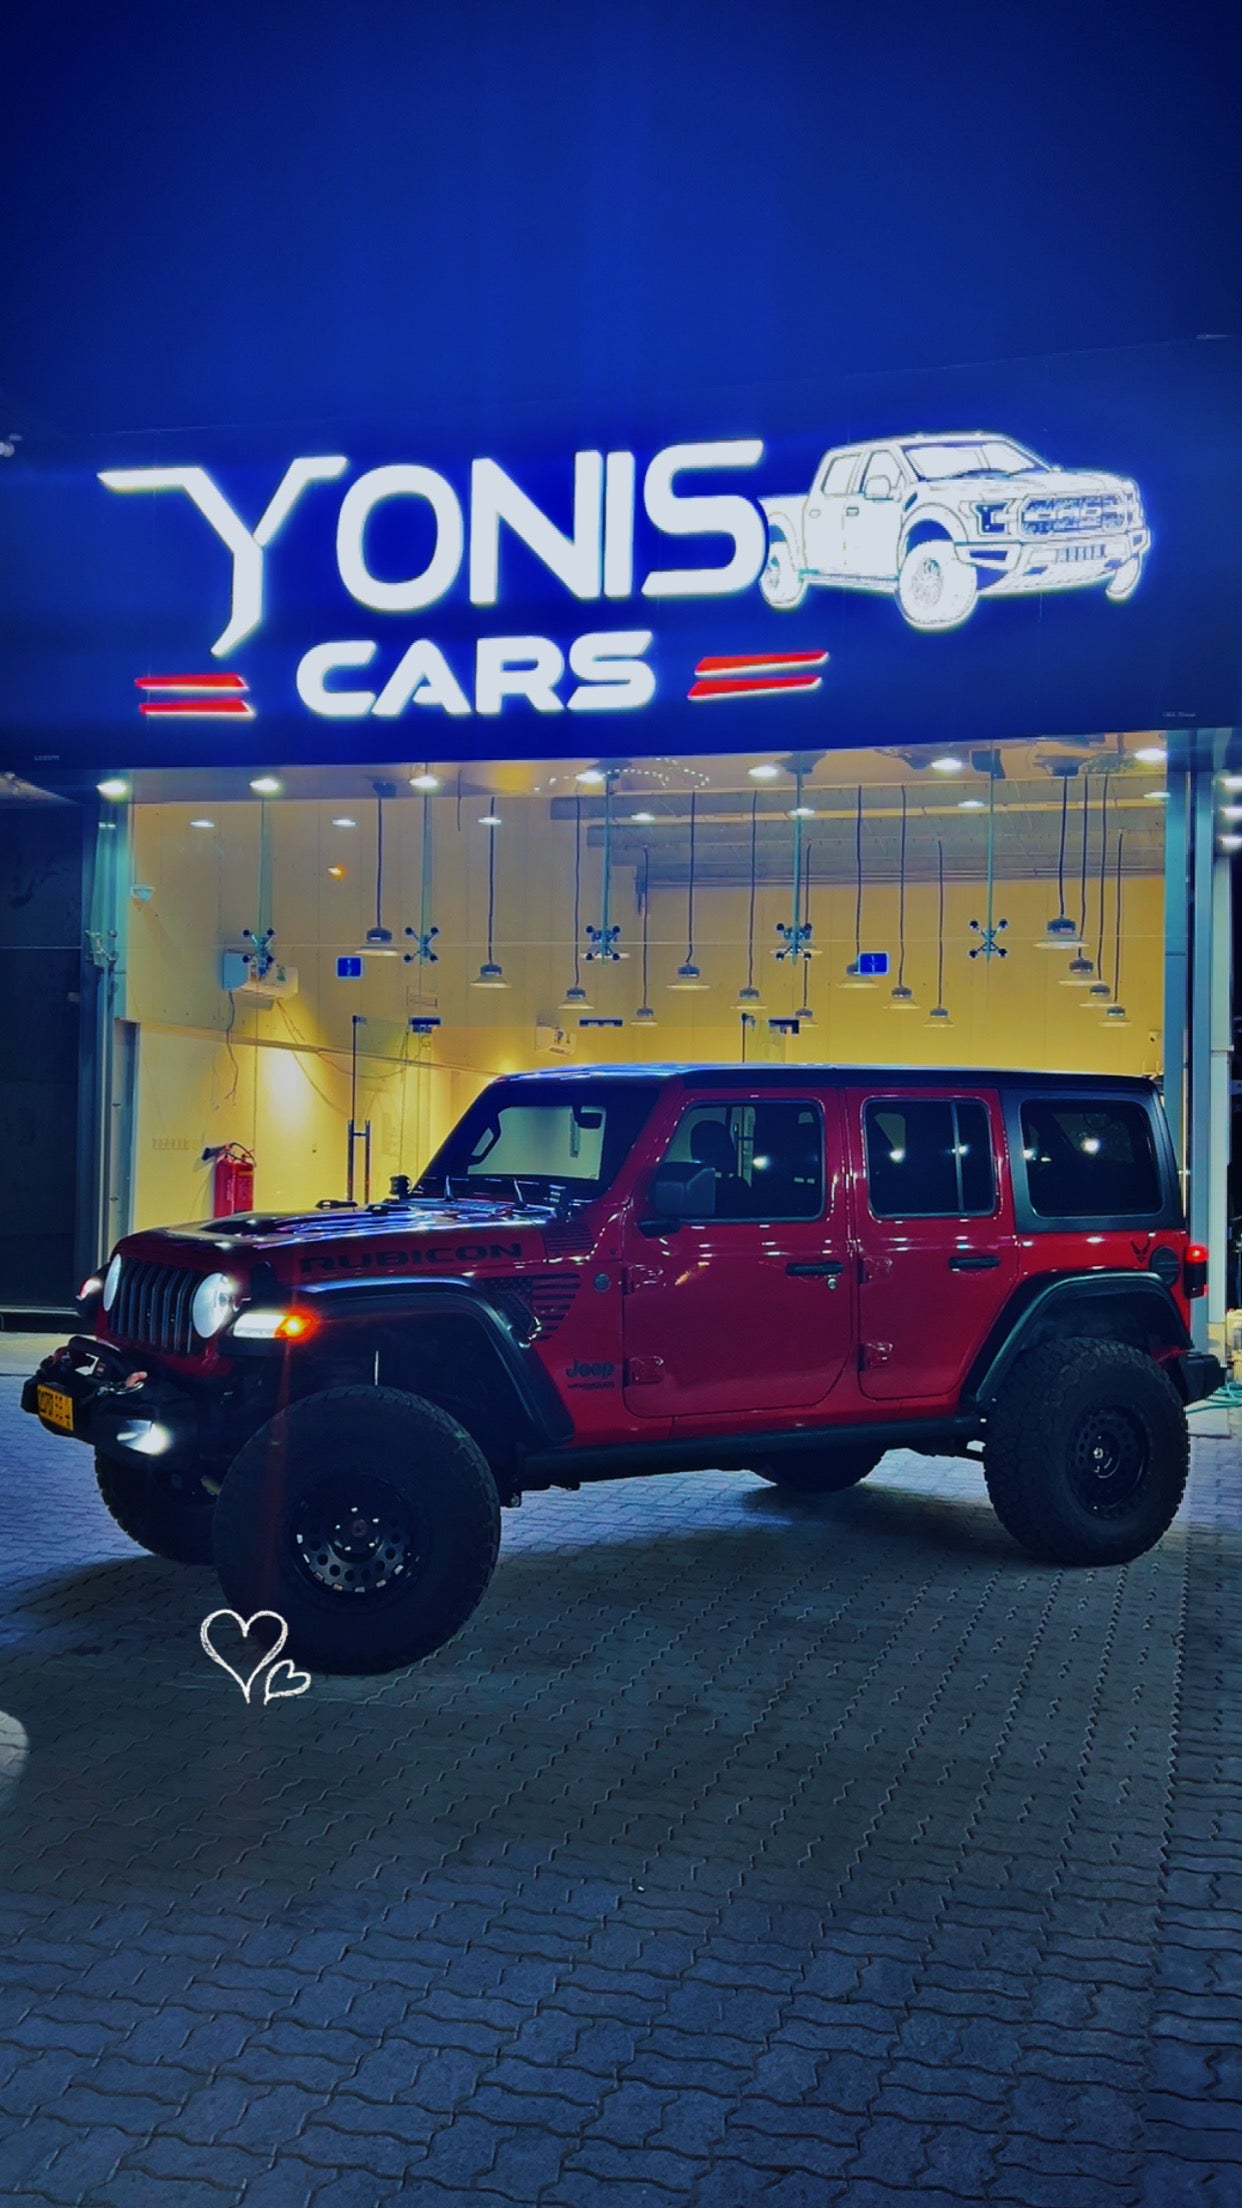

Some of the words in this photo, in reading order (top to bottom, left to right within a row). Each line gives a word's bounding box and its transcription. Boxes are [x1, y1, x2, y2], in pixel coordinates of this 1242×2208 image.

[97, 440, 766, 657] YONIS
[296, 631, 656, 715] CARS
[301, 1243, 522, 1272] RUBICON
[566, 1359, 615, 1378] Jeep
